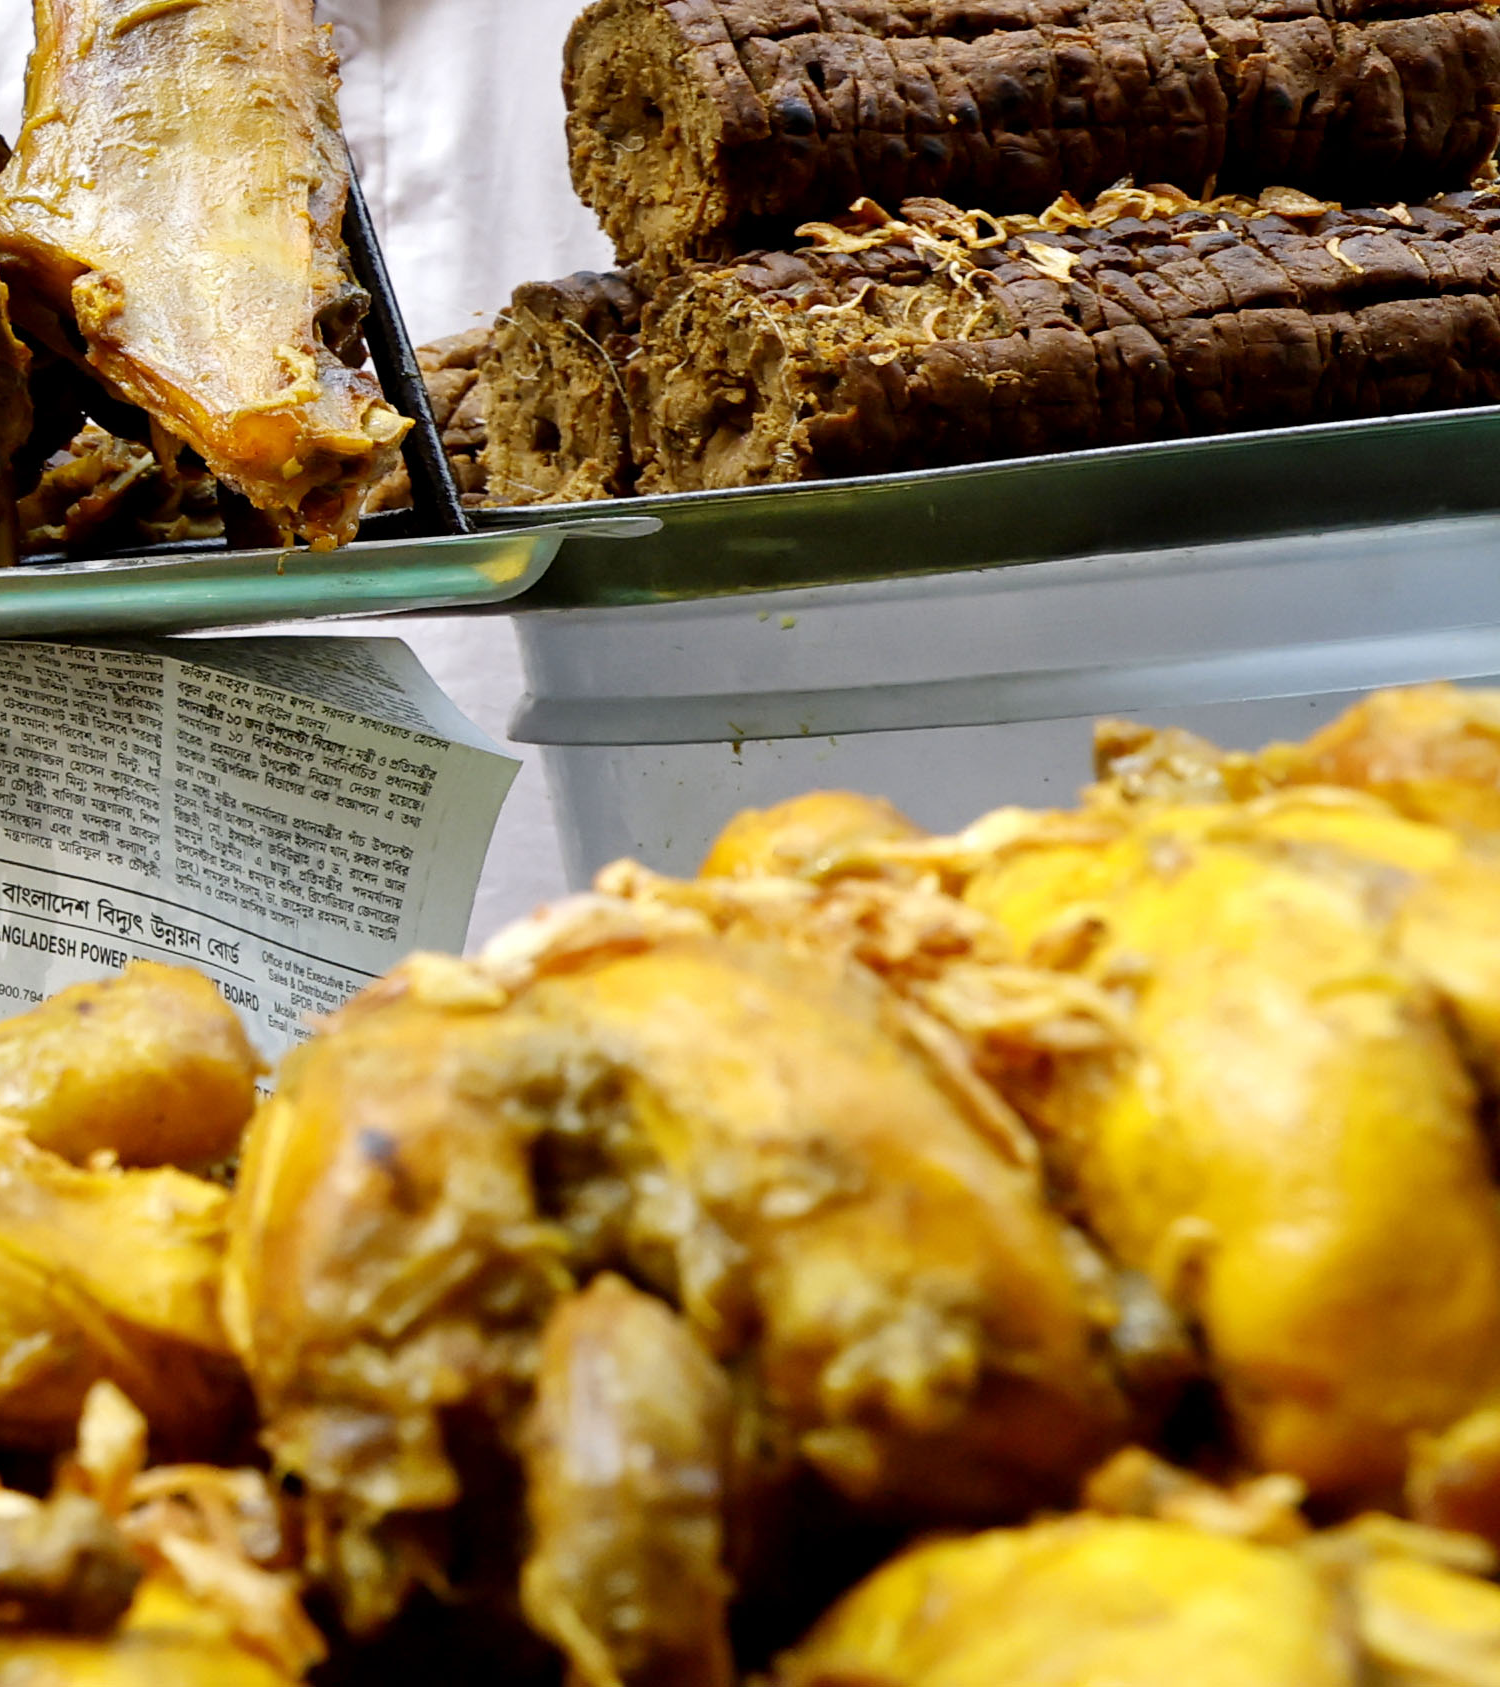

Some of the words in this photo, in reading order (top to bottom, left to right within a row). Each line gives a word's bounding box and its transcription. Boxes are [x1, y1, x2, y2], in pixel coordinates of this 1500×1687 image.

[1, 881, 89, 920] বাংলাদেশ
[98, 897, 144, 936] বিদ্যুৎ
[151, 911, 202, 952] উন্নয়ন
[207, 937, 242, 965] বোর্ড
[81, 942, 128, 971] POWER
[223, 978, 260, 1013] BOARD
[268, 968, 289, 986] Sales
[297, 981, 339, 1005] Distribution
[306, 964, 345, 991] Executive
